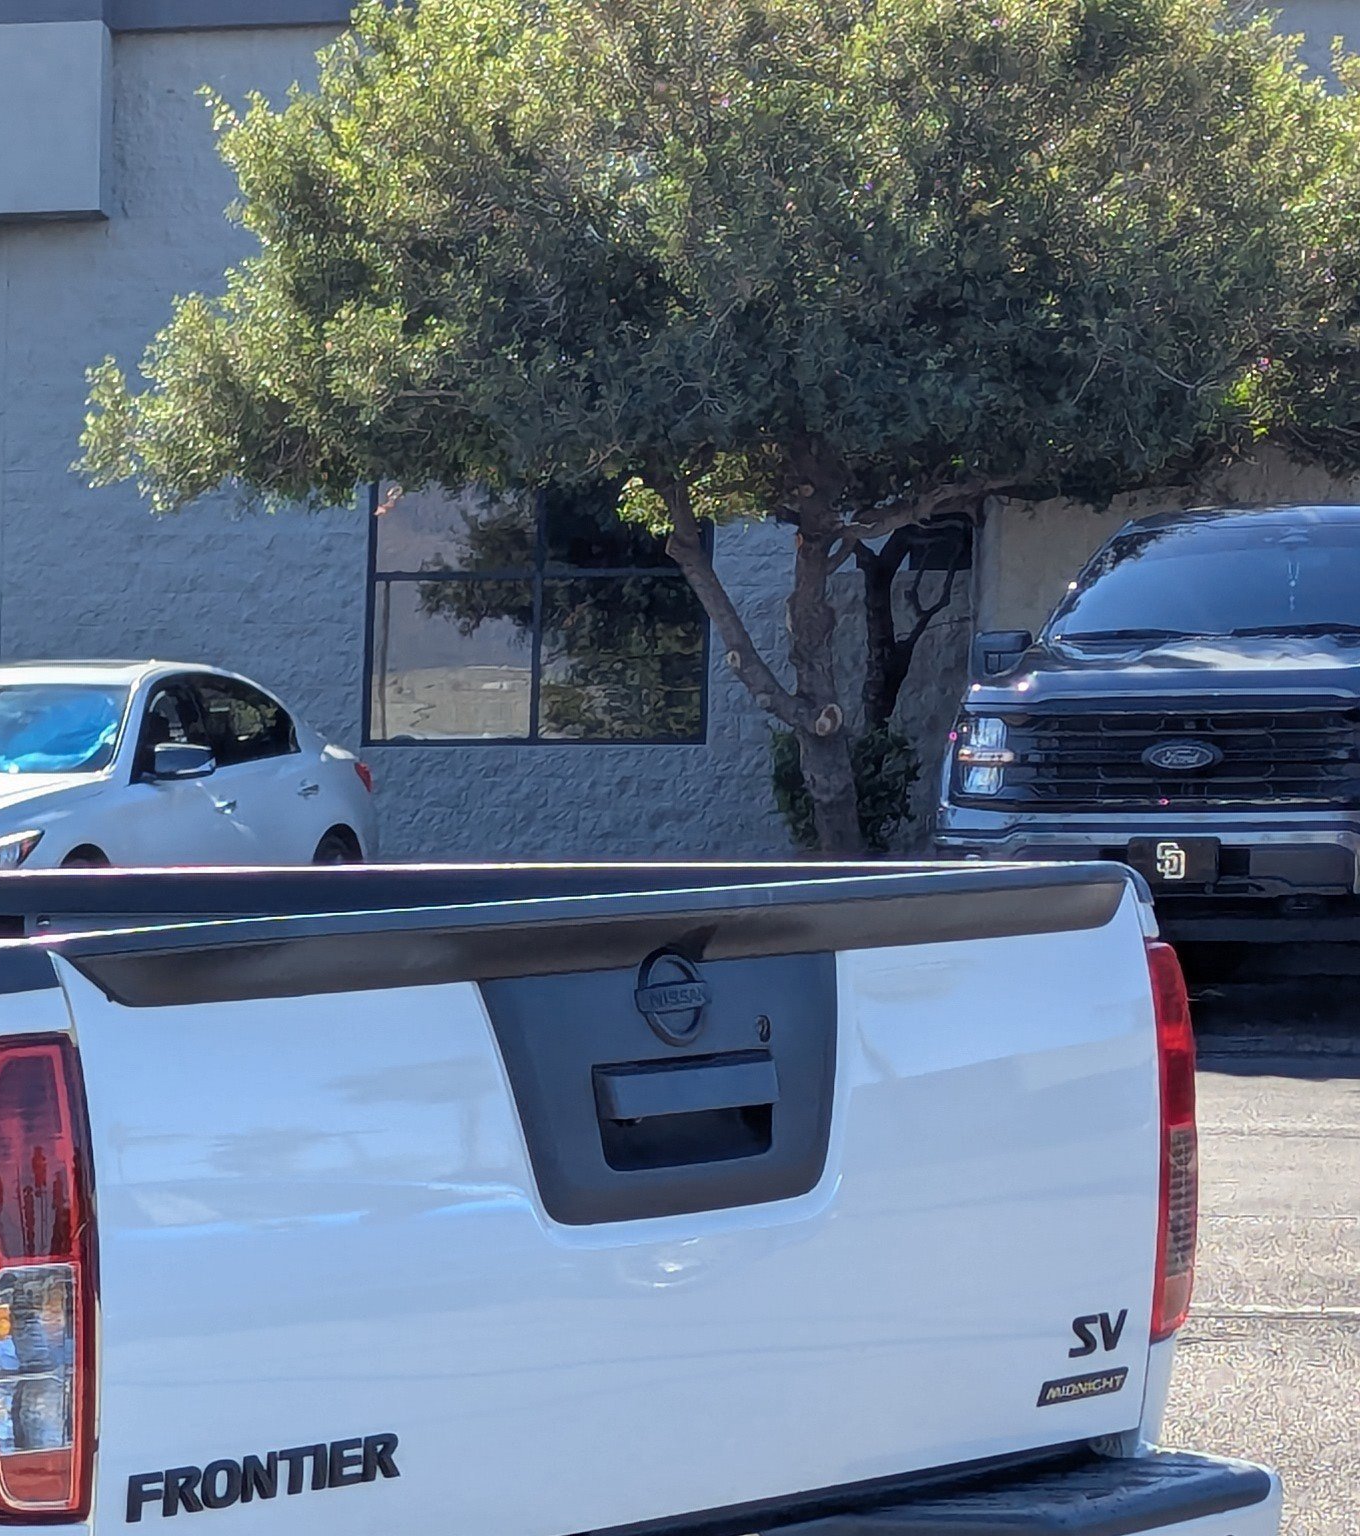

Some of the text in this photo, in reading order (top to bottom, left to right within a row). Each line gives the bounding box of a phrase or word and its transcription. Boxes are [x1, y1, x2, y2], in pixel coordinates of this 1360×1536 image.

[1068, 1308, 1129, 1358] SV
[1045, 1374, 1125, 1400] MIDNIGHT
[125, 1432, 401, 1523] FRONTIER
